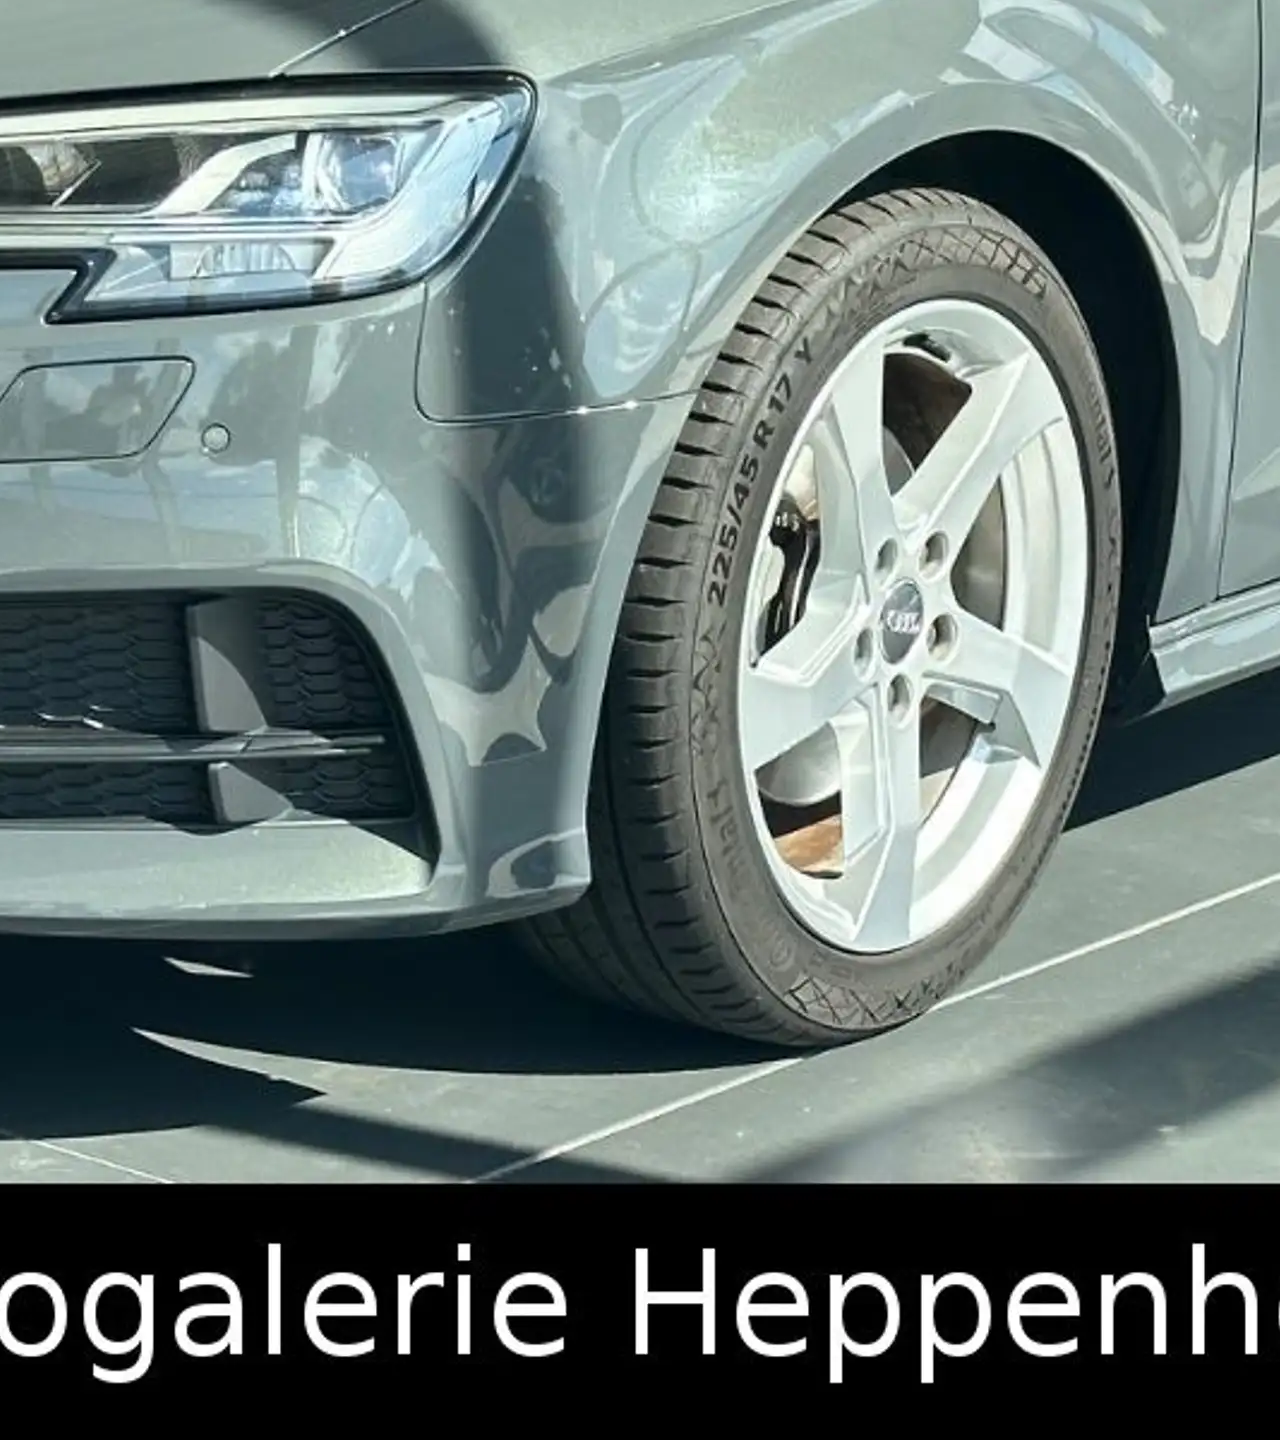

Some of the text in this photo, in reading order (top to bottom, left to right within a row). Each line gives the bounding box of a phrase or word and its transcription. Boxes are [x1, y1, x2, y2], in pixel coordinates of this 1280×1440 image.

[707, 454, 760, 607] 225/45
[752, 419, 775, 450] R
[767, 372, 792, 415] 17
